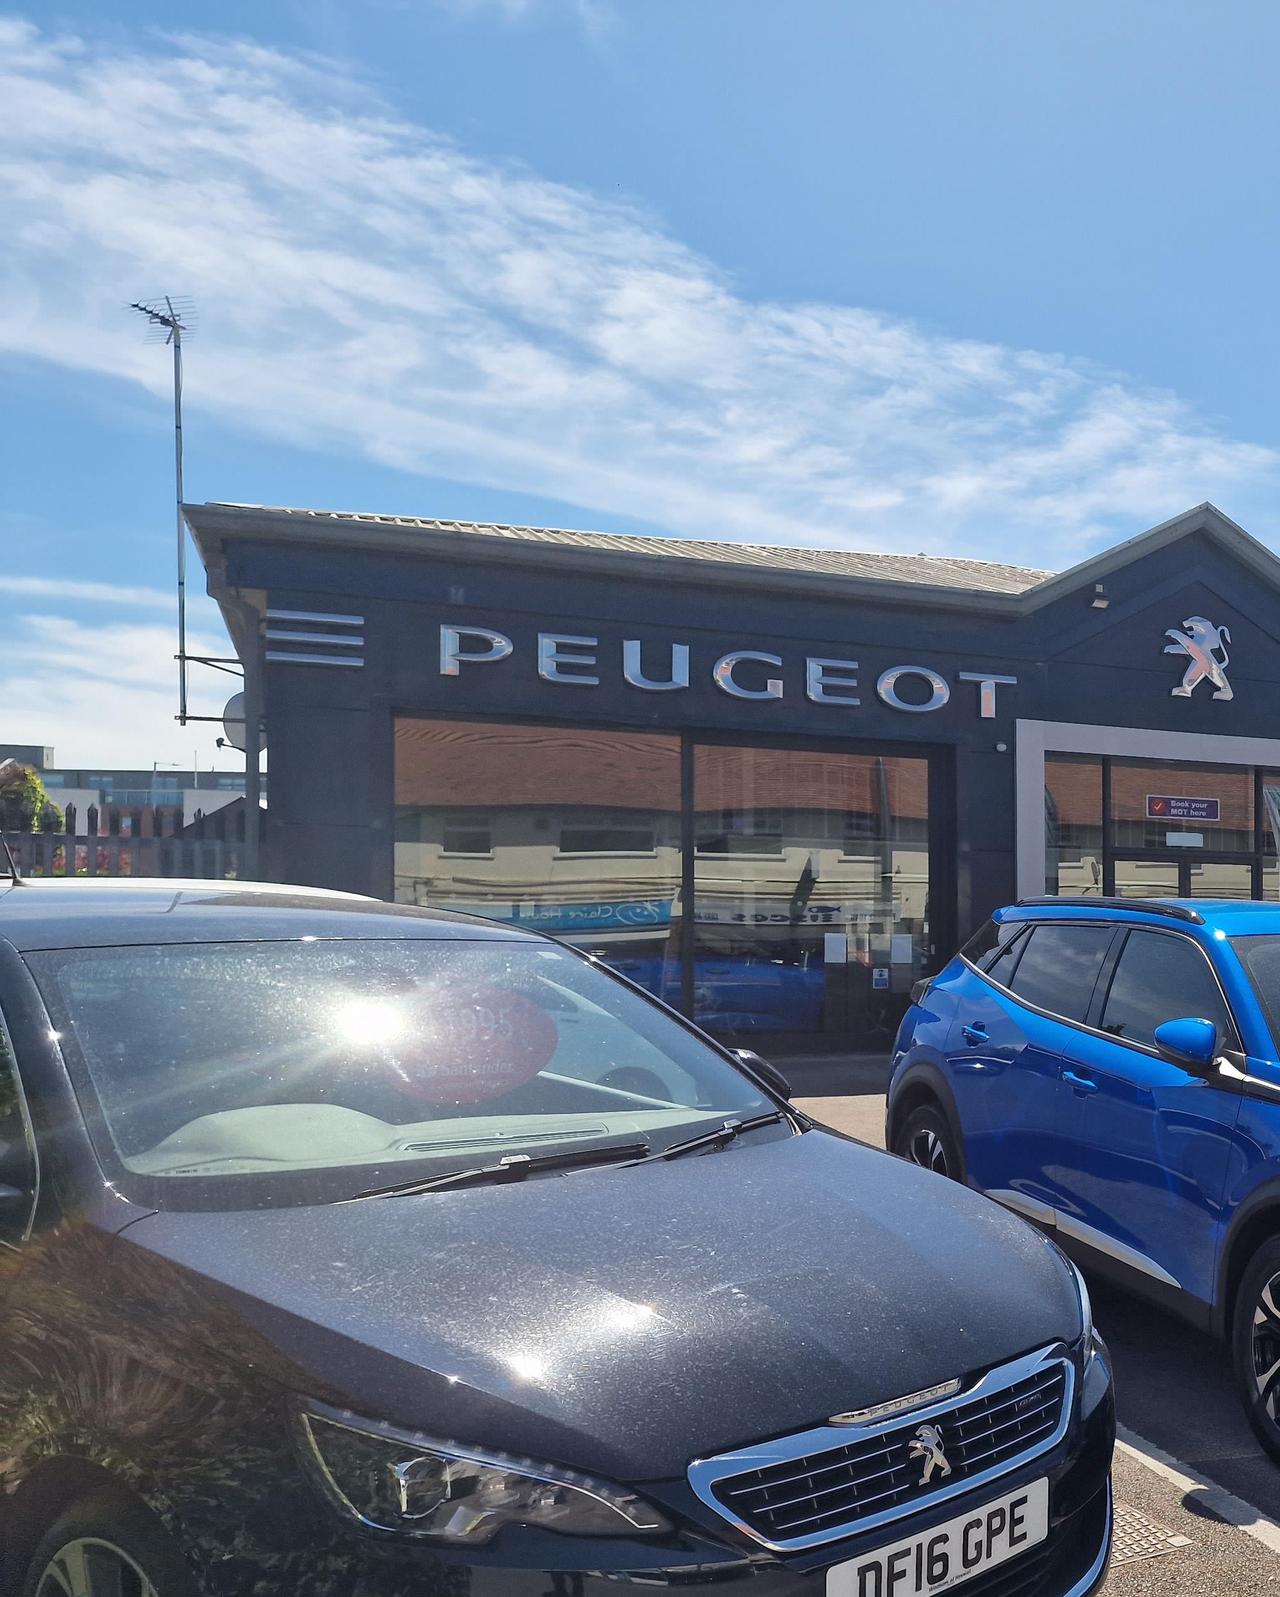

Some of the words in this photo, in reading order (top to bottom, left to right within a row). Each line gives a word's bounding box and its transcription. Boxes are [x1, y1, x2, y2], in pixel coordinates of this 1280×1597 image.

[440, 623, 1018, 719] PEUGEOT
[1170, 800, 1190, 808] Book
[1170, 808, 1188, 816] MOT
[1190, 809, 1207, 817] here
[857, 1532, 950, 1597] DF16
[962, 1494, 1029, 1570] GPE
